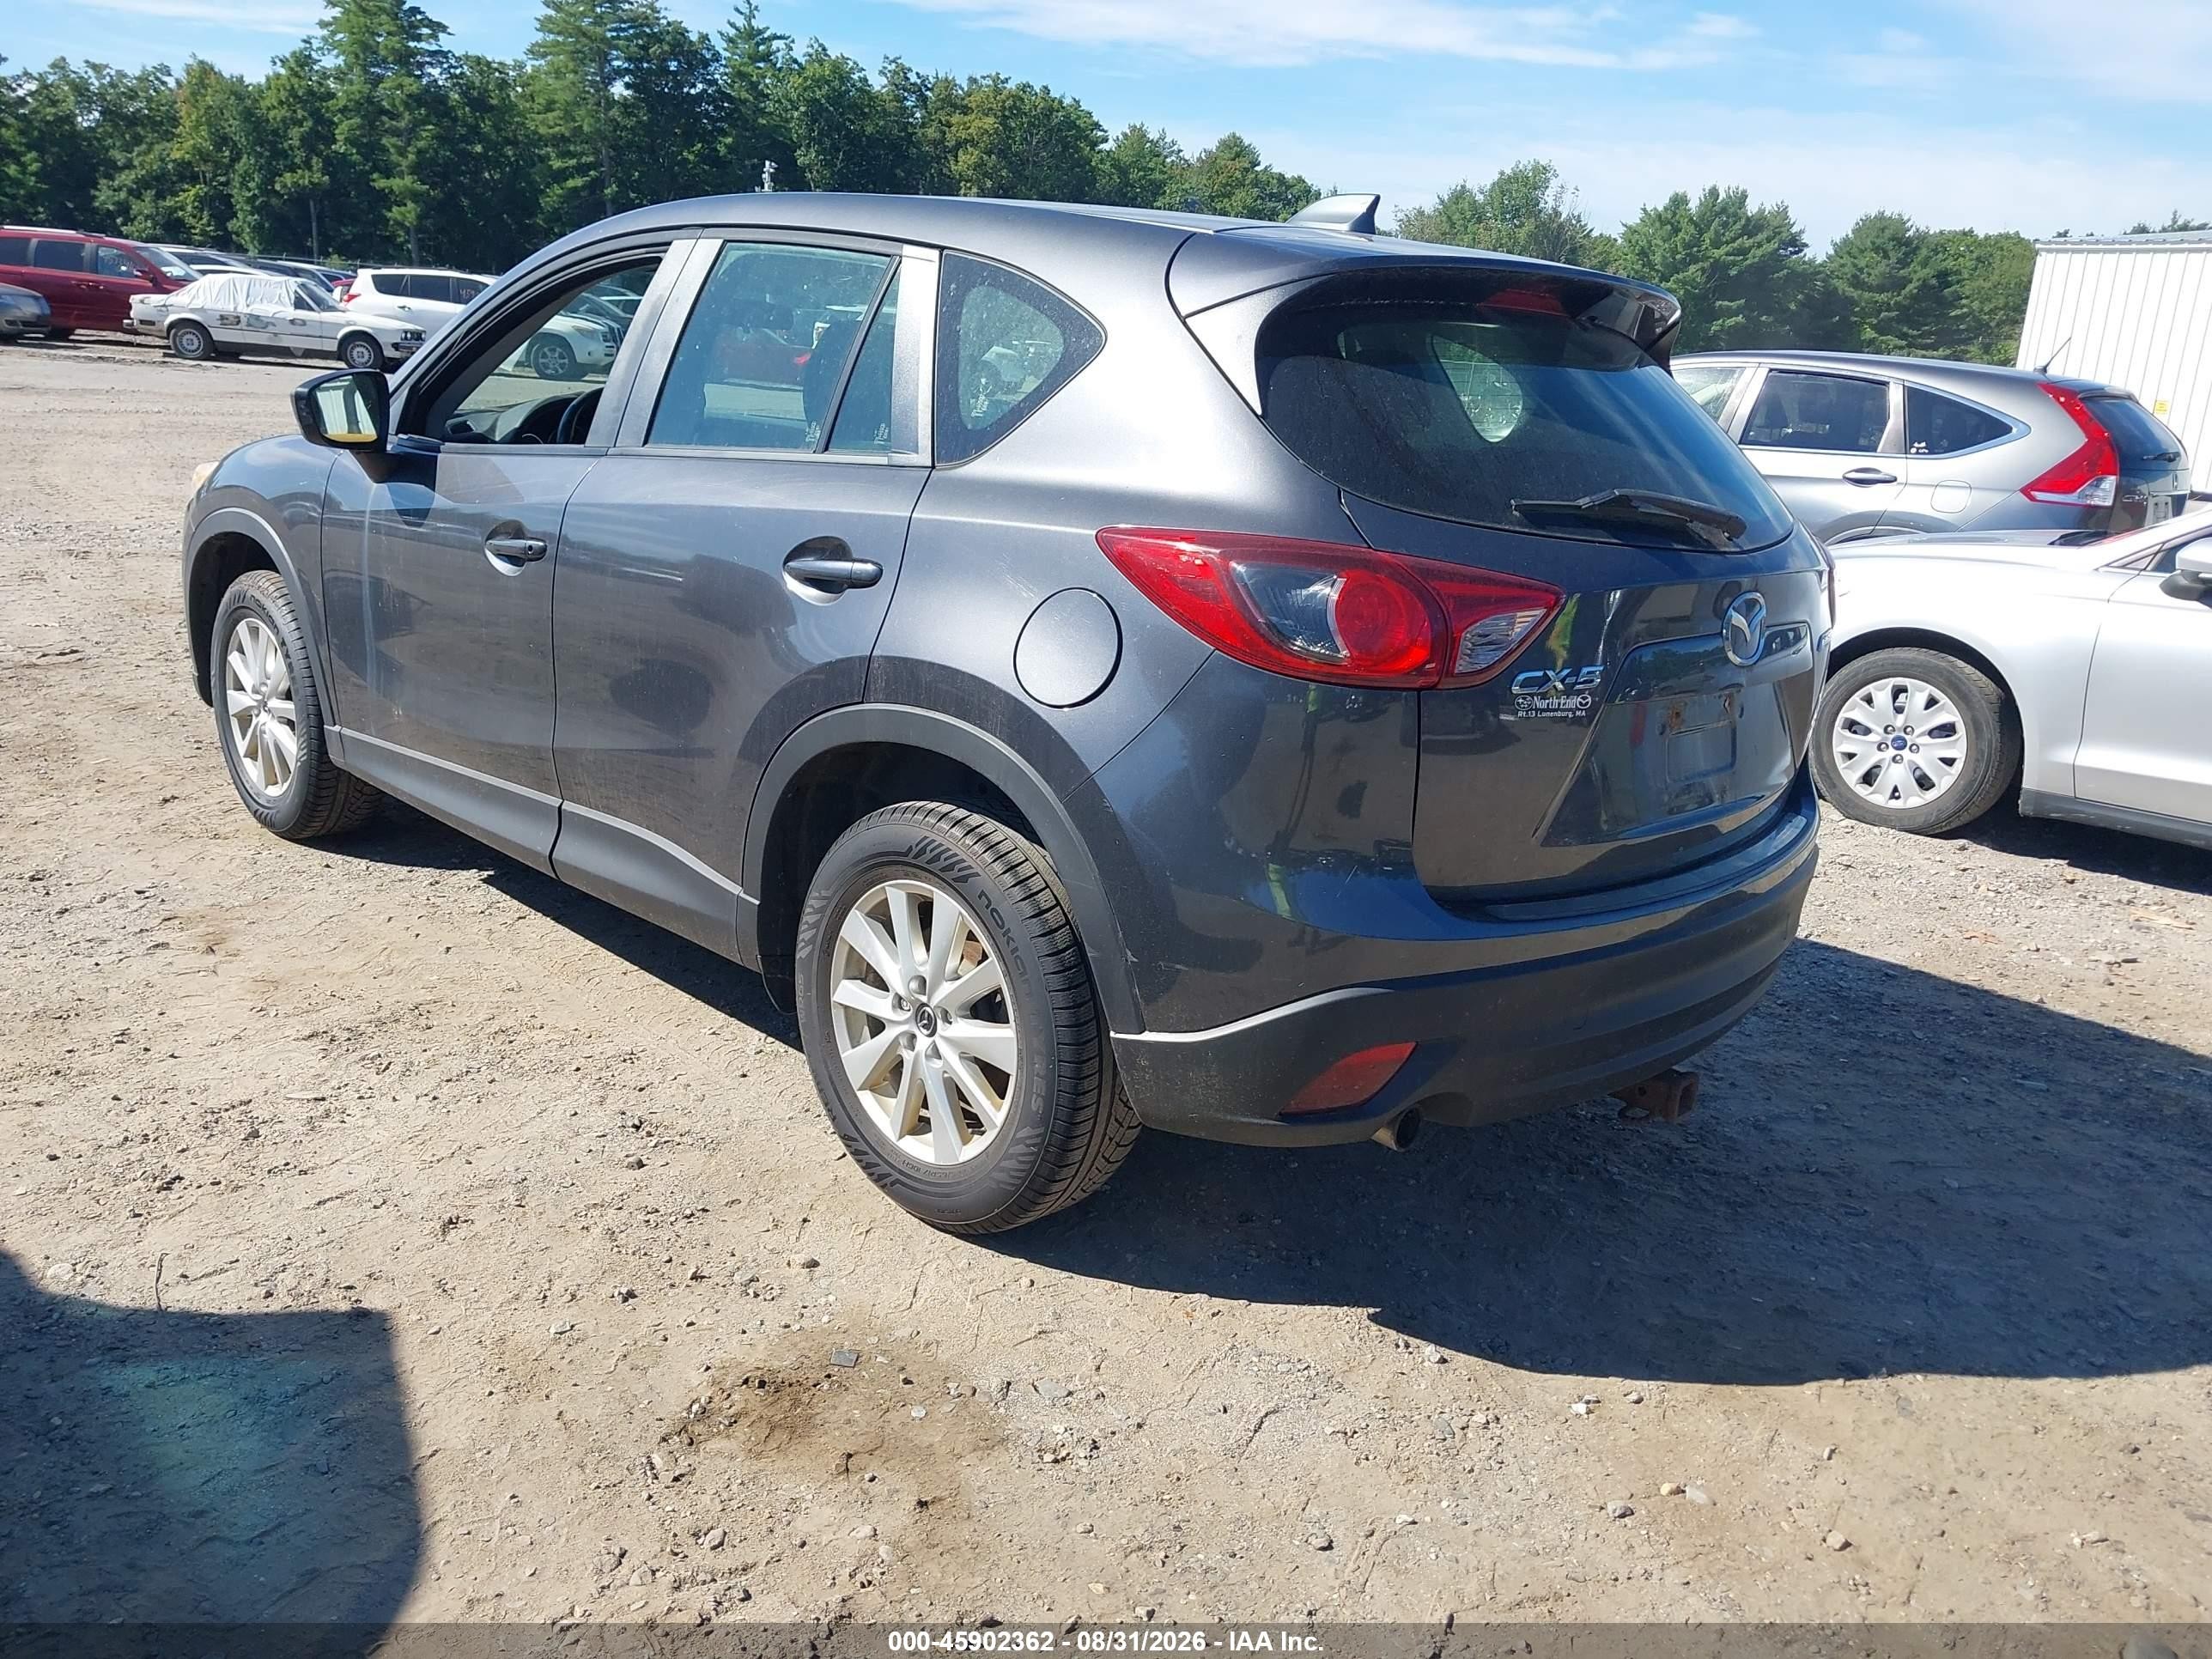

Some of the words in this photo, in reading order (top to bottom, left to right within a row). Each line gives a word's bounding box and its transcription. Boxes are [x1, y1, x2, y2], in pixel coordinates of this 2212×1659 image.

[1511, 665, 1605, 694] CX-5
[1533, 695, 1559, 709] North
[1559, 695, 1577, 709] End
